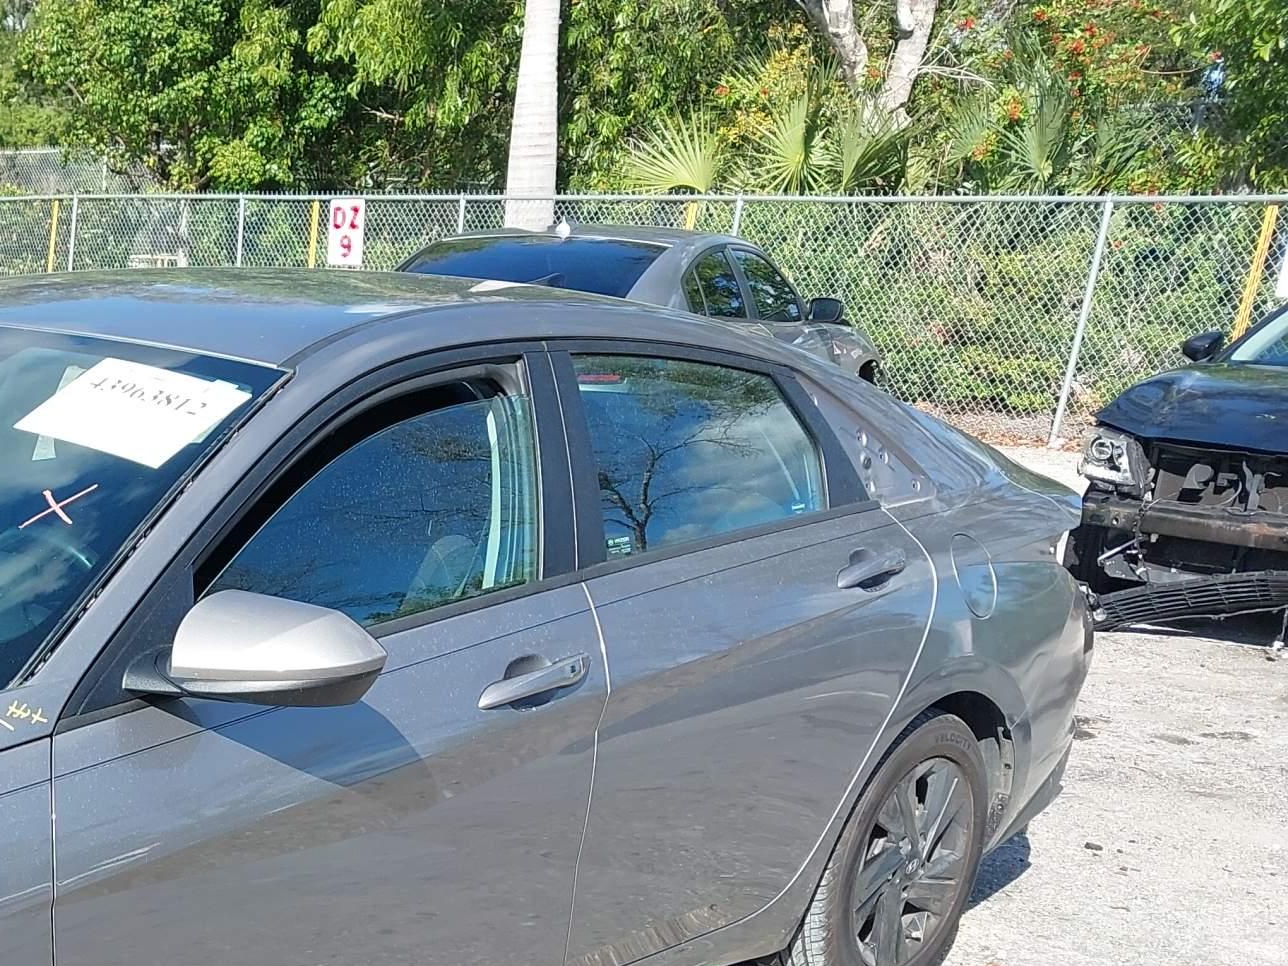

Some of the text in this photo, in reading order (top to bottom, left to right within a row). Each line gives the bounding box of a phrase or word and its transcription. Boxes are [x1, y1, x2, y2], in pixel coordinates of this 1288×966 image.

[333, 205, 361, 229] DZ
[340, 235, 352, 257] 9
[89, 377, 208, 415] 43963812
